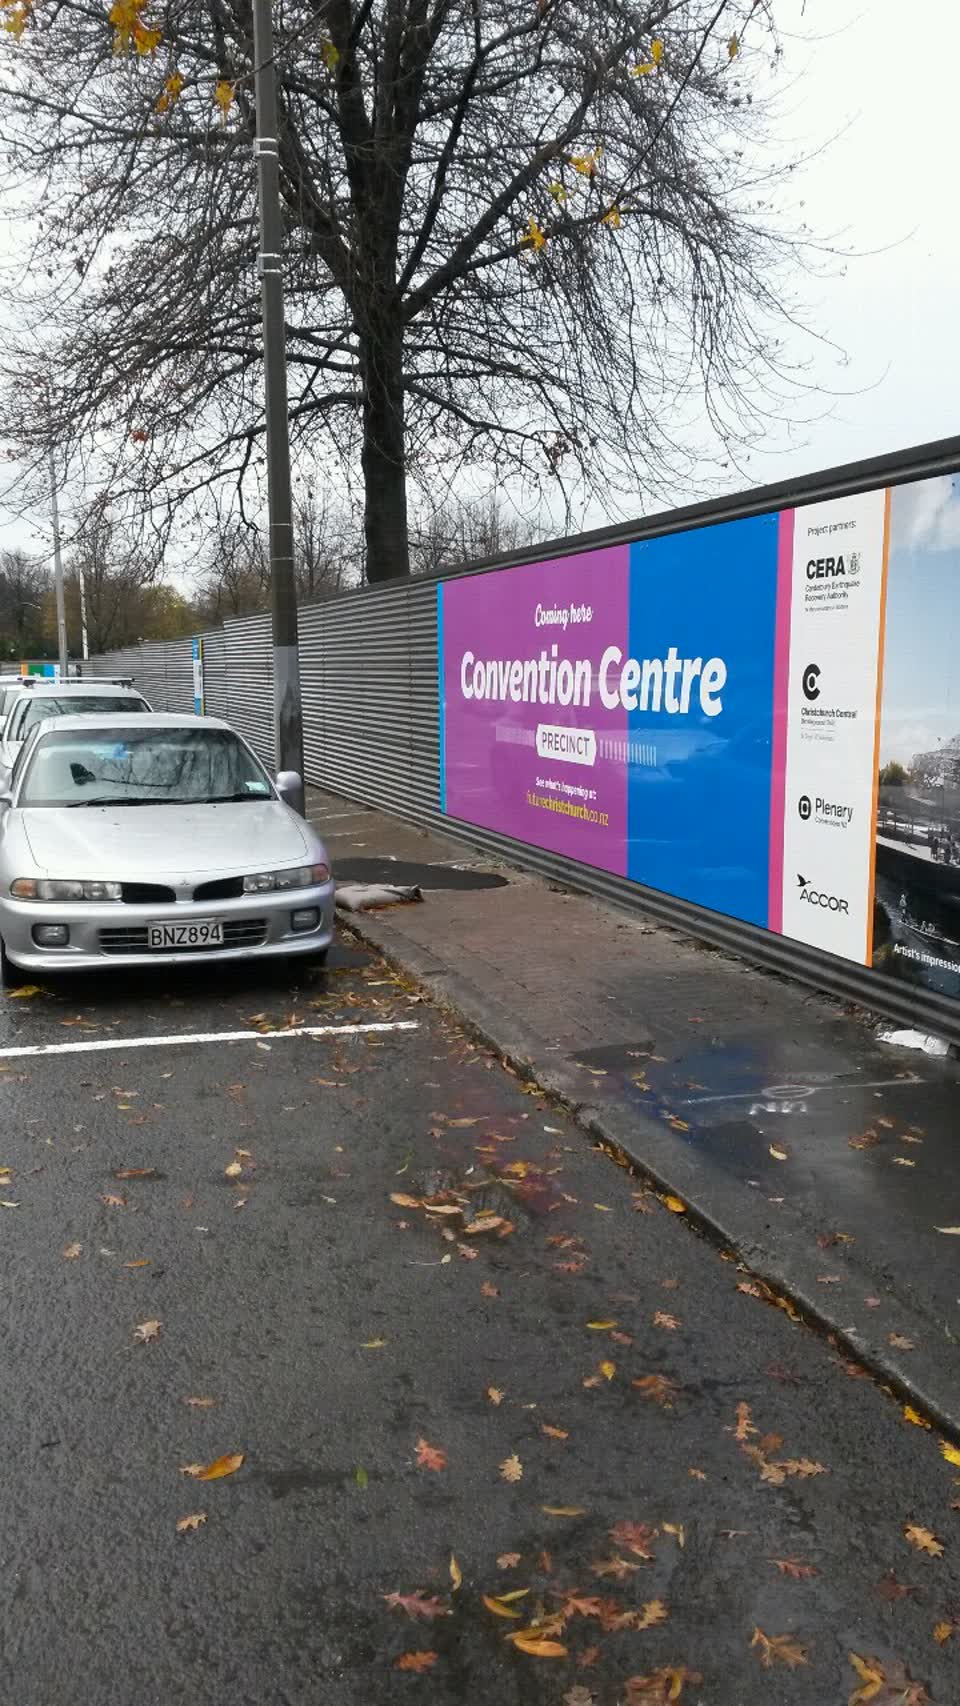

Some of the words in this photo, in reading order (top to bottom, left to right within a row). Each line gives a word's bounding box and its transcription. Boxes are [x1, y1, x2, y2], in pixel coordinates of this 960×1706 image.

[807, 526, 828, 536] Project
[806, 555, 846, 580] CERA
[535, 603, 569, 631] Coming
[570, 602, 594, 624] here
[461, 644, 592, 706] Convention
[599, 646, 727, 716] Centre
[542, 731, 590, 756] PRECINCT
[815, 797, 853, 823] Plenary
[800, 888, 849, 915] ACCOR
[151, 924, 221, 946] BNZ894
[893, 943, 920, 960] Artist's
